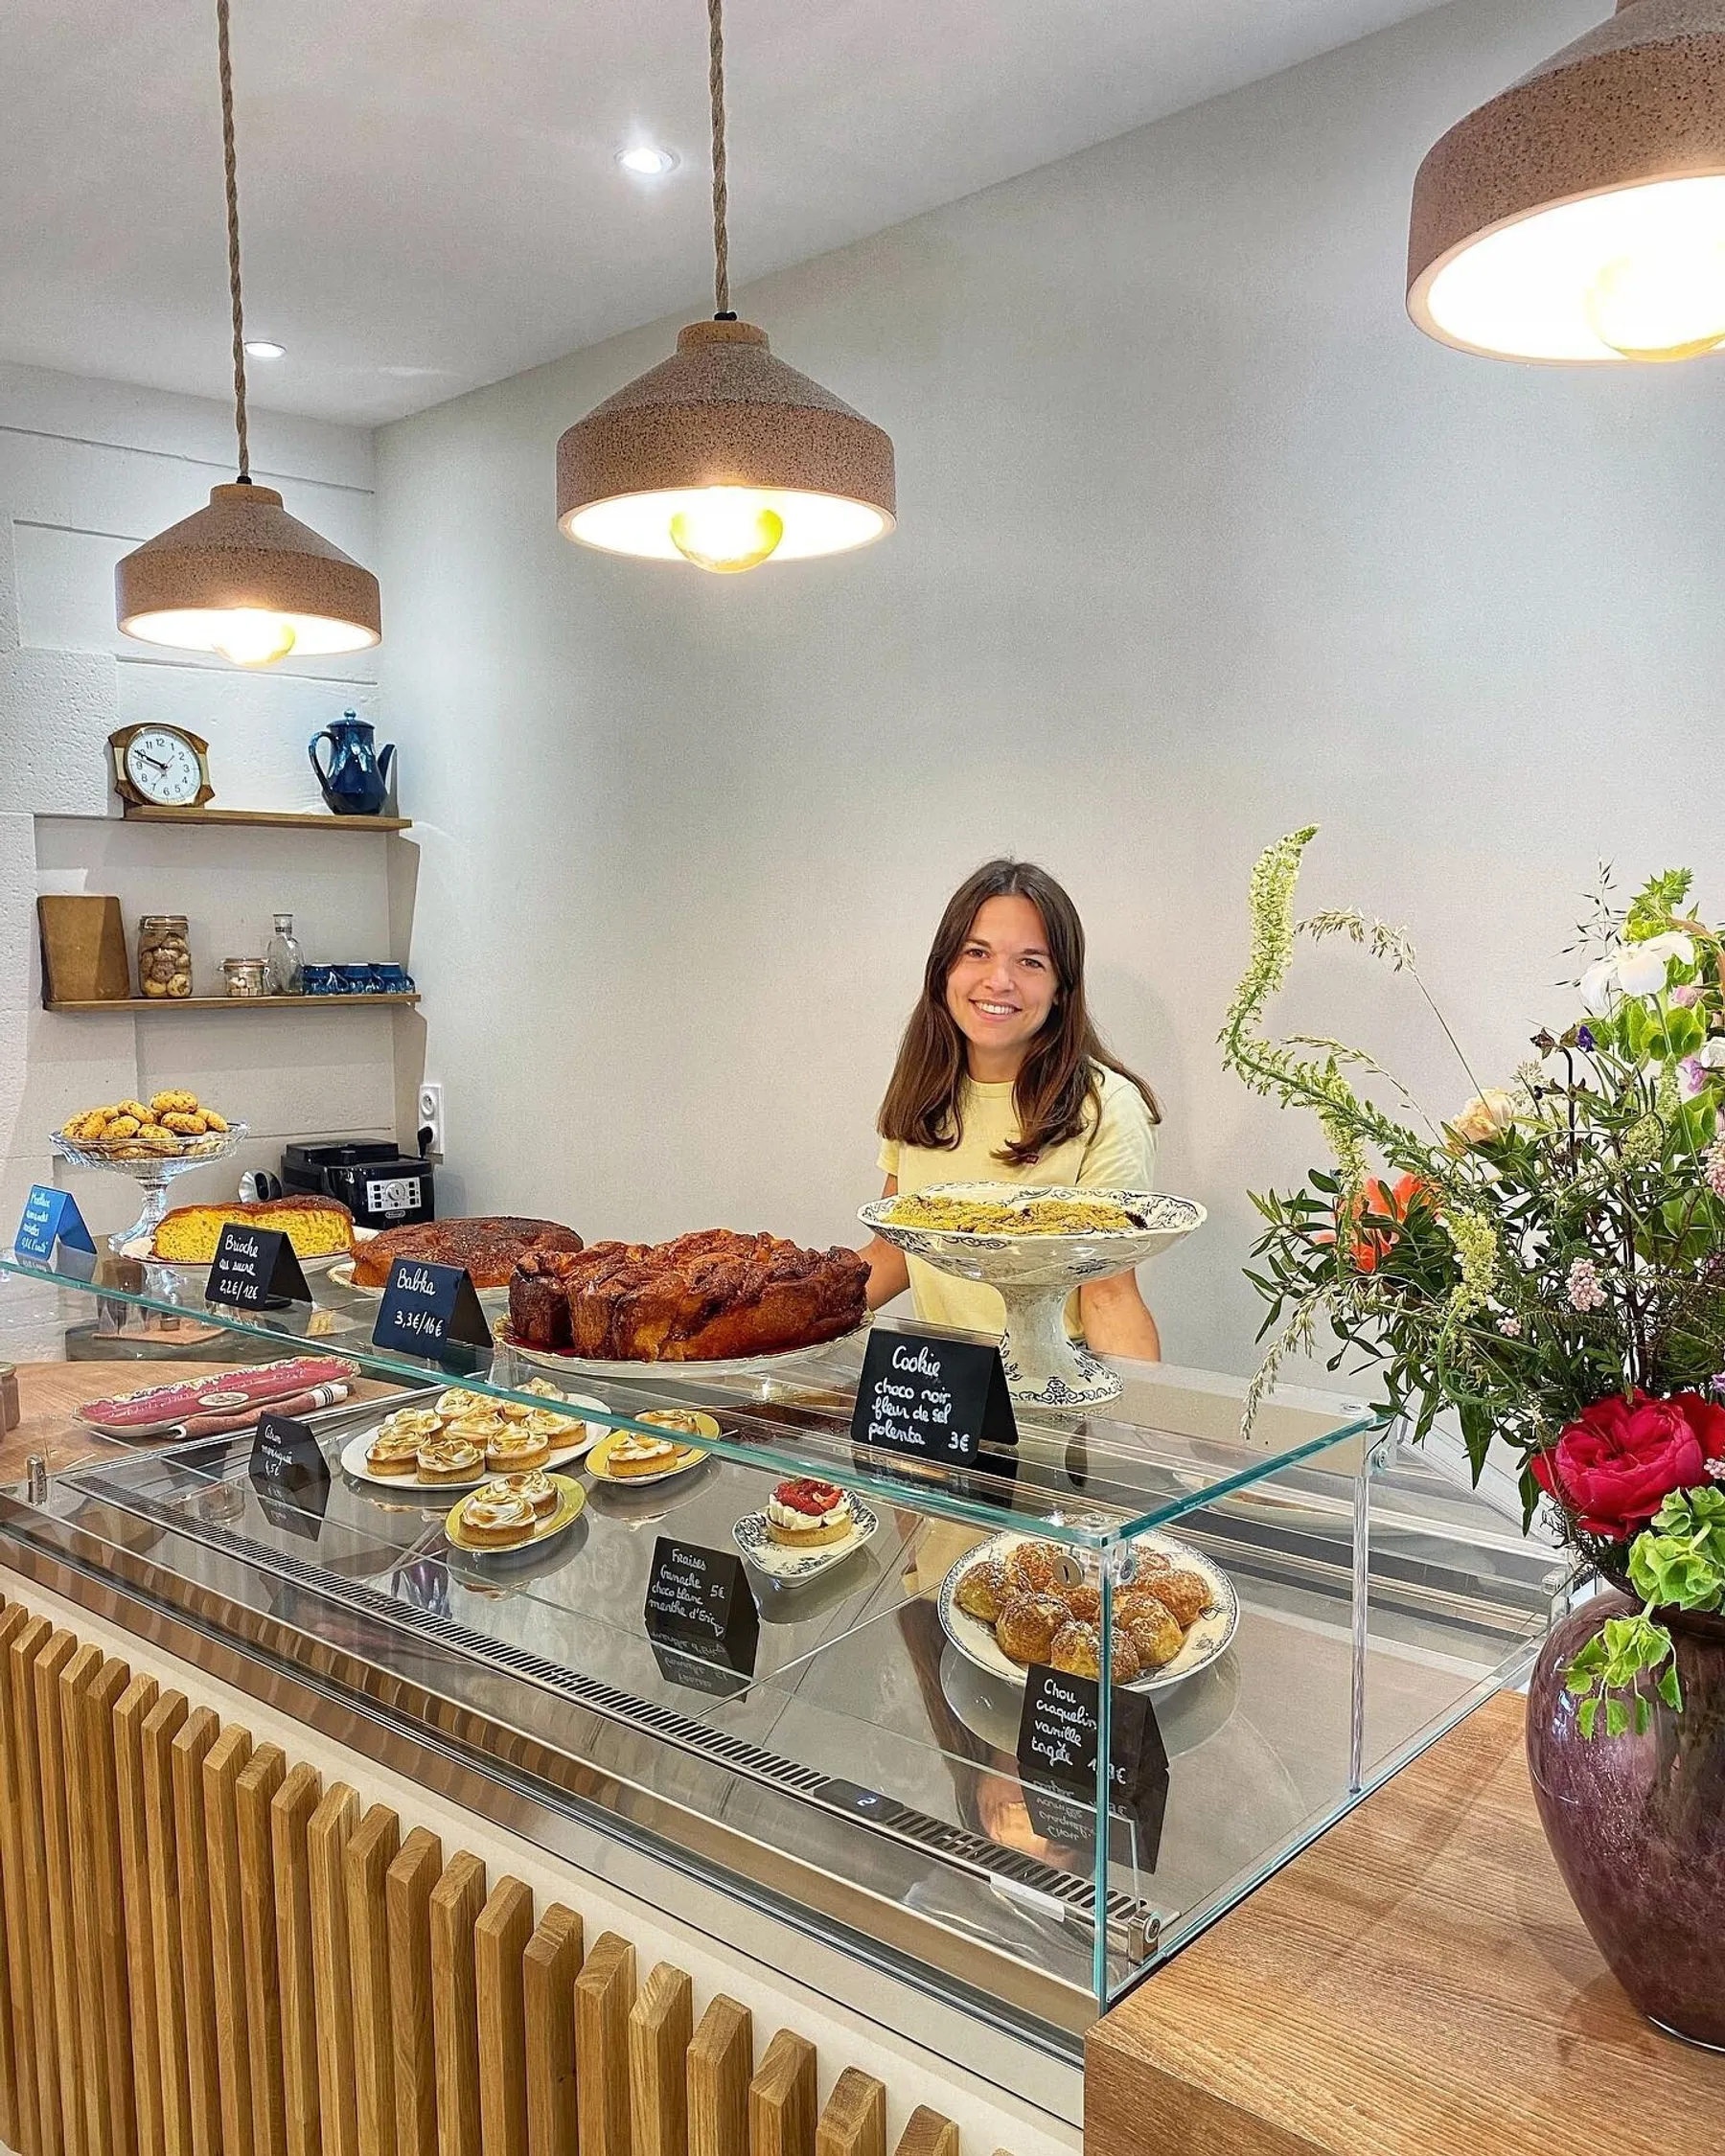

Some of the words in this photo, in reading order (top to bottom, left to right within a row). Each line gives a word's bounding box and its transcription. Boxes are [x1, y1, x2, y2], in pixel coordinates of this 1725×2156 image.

[145, 741, 153, 749] 11
[156, 738, 166, 747] 12
[136, 761, 143, 770] 9
[178, 751, 185, 761] 2
[141, 773, 148, 783] 8
[183, 764, 190, 773] 3
[163, 788, 171, 796] 6
[174, 785, 181, 793] 5
[182, 776, 188, 785] 4
[224, 1234, 259, 1258] Brioche
[219, 1258, 230, 1271] au
[232, 1262, 256, 1276] sucre
[397, 1268, 436, 1296] Babka
[394, 1311, 444, 1337] 3,3€/16€
[892, 1345, 941, 1377] Cookie
[874, 1377, 914, 1400] choco
[921, 1387, 952, 1404] noir
[871, 1396, 909, 1420] fleur
[912, 1404, 930, 1422] de
[932, 1403, 953, 1424] sel
[868, 1418, 926, 1446] polenta
[948, 1431, 971, 1453] 3€
[660, 1564, 702, 1590] Ganache
[710, 1584, 725, 1599] 5€
[652, 1582, 675, 1597] choco
[677, 1587, 703, 1605] blanc
[648, 1598, 687, 1617] menthe
[1044, 1678, 1076, 1704] Chou
[1036, 1700, 1097, 1731] craquelin
[1034, 1720, 1082, 1748] vanille
